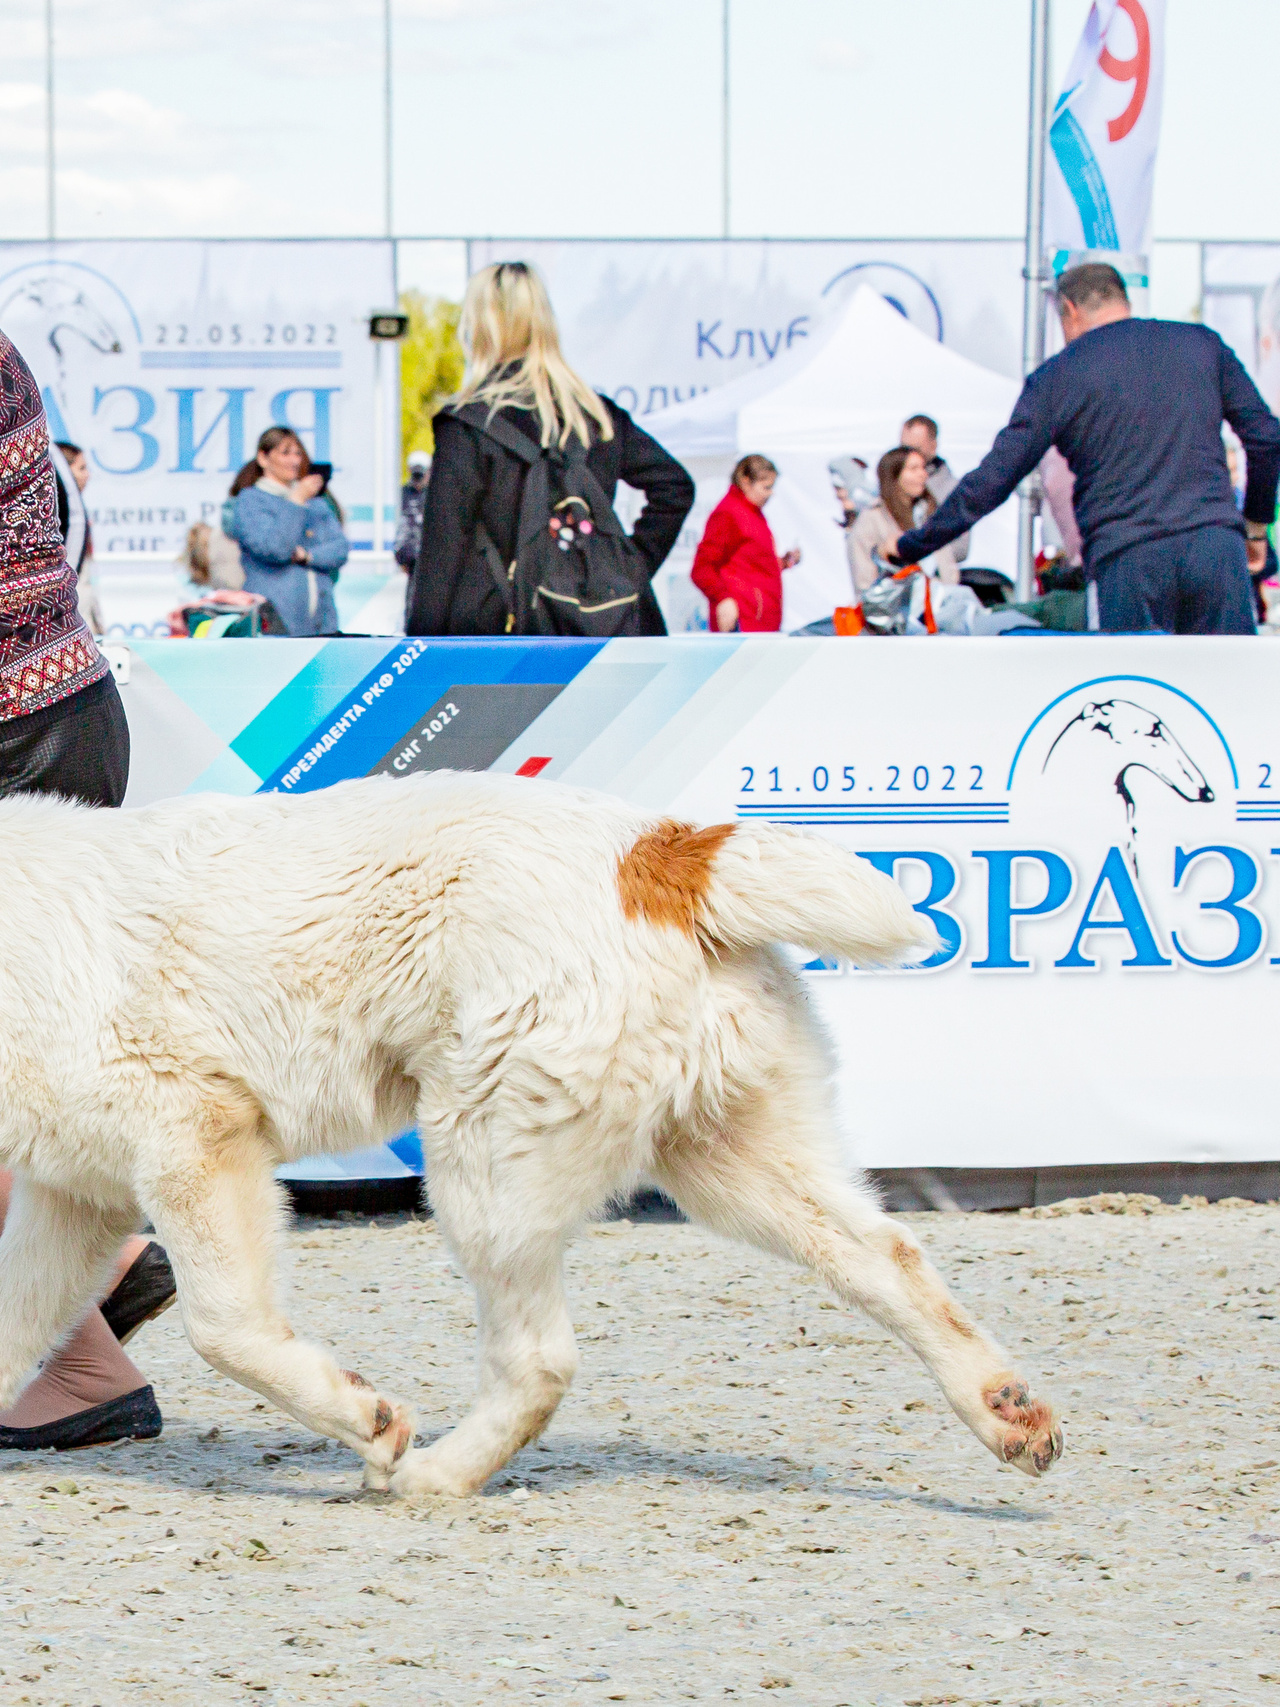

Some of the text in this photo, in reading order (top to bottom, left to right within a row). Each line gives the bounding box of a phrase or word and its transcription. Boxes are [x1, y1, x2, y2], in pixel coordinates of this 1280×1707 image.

[1097, 0, 1151, 142] 9
[156, 324, 337, 344] 22.05.2022
[280, 639, 428, 789] ПРЕЗИДЕНТА РКФ 2022
[392, 702, 461, 772] СНГ 2022
[740, 765, 985, 792] 21.05.2022
[1257, 764, 1272, 789] 2
[803, 845, 1280, 969] ВРАЗ
